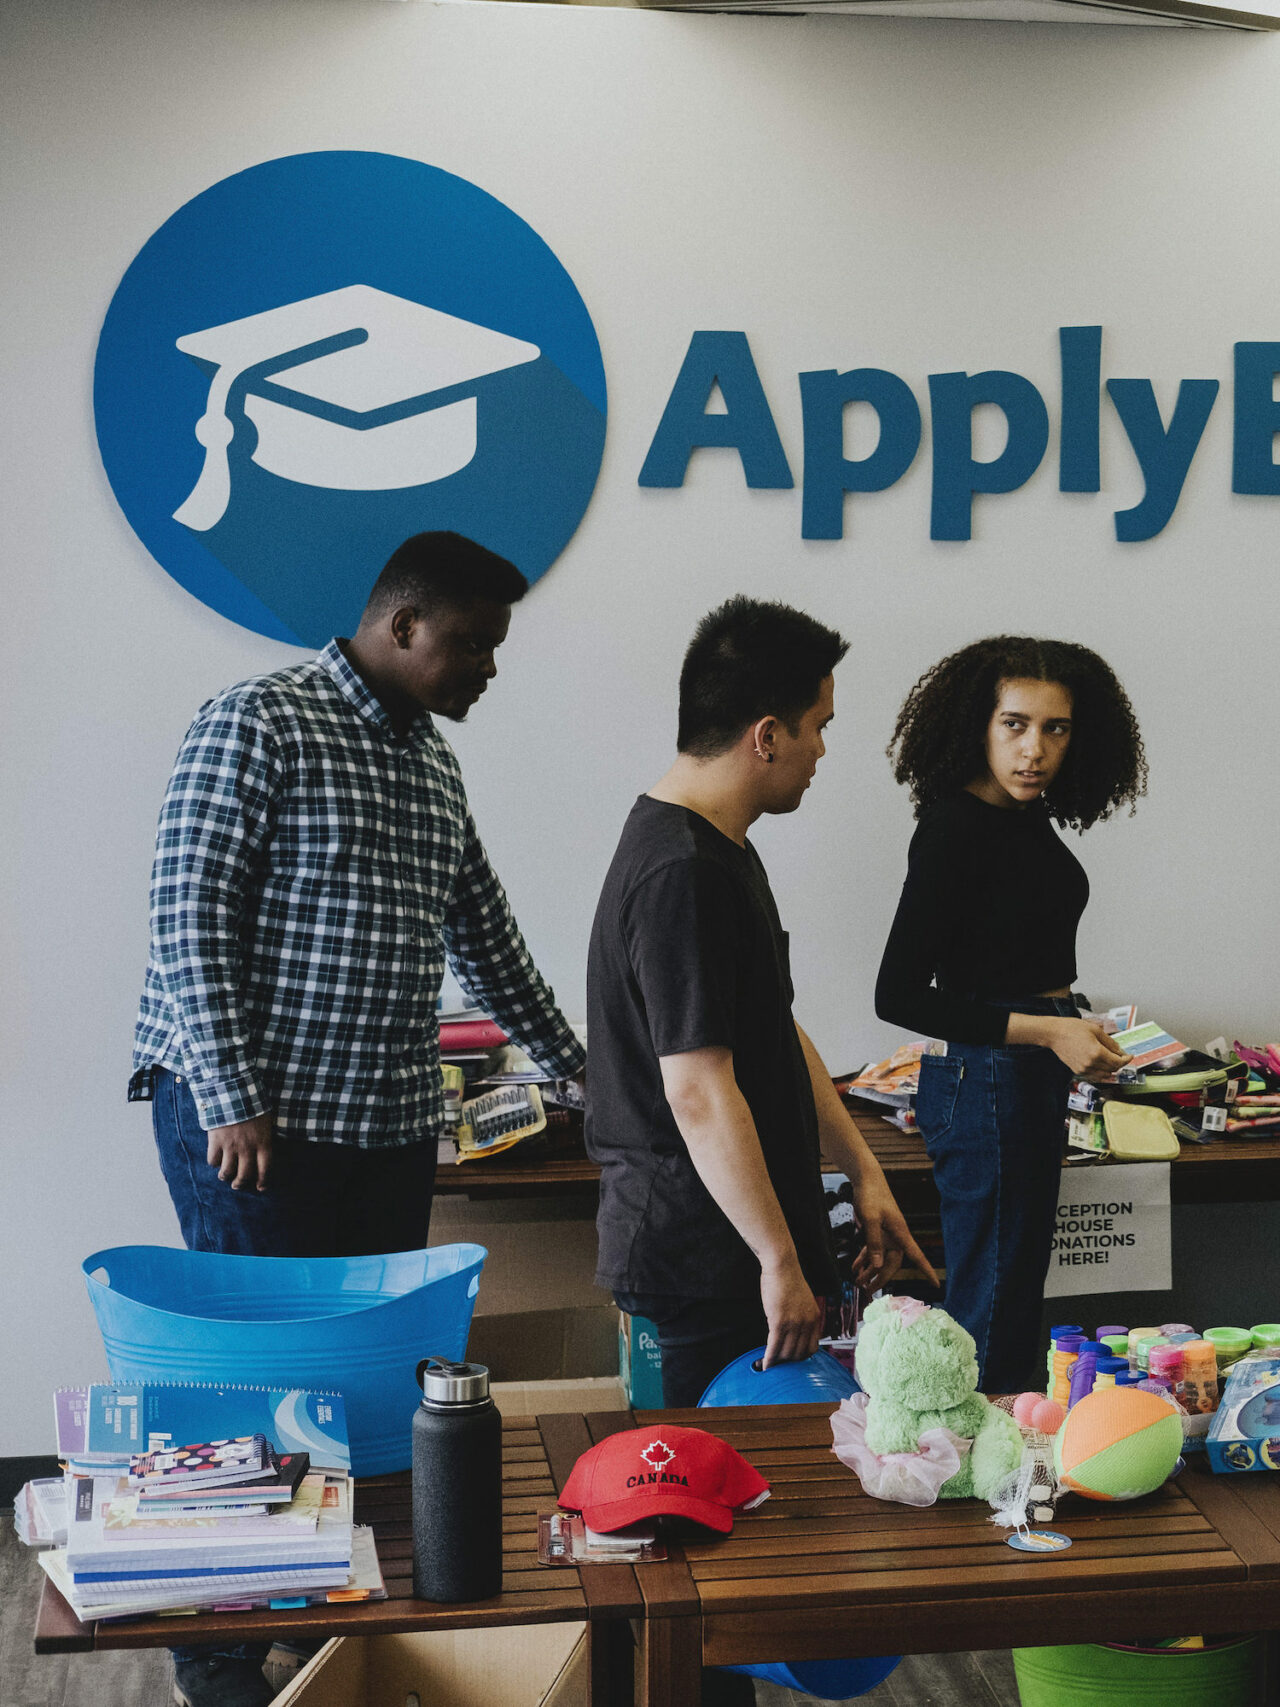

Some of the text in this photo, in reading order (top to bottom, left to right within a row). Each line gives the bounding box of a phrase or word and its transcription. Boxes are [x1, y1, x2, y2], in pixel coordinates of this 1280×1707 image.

[1057, 1201, 1133, 1218] CEPTION
[1054, 1218, 1114, 1234] HOUSE
[1051, 1233, 1136, 1250] ONATIONS
[1059, 1250, 1109, 1266] HERE!
[638, 1332, 661, 1351] Pa
[626, 1472, 689, 1488] CANADA
